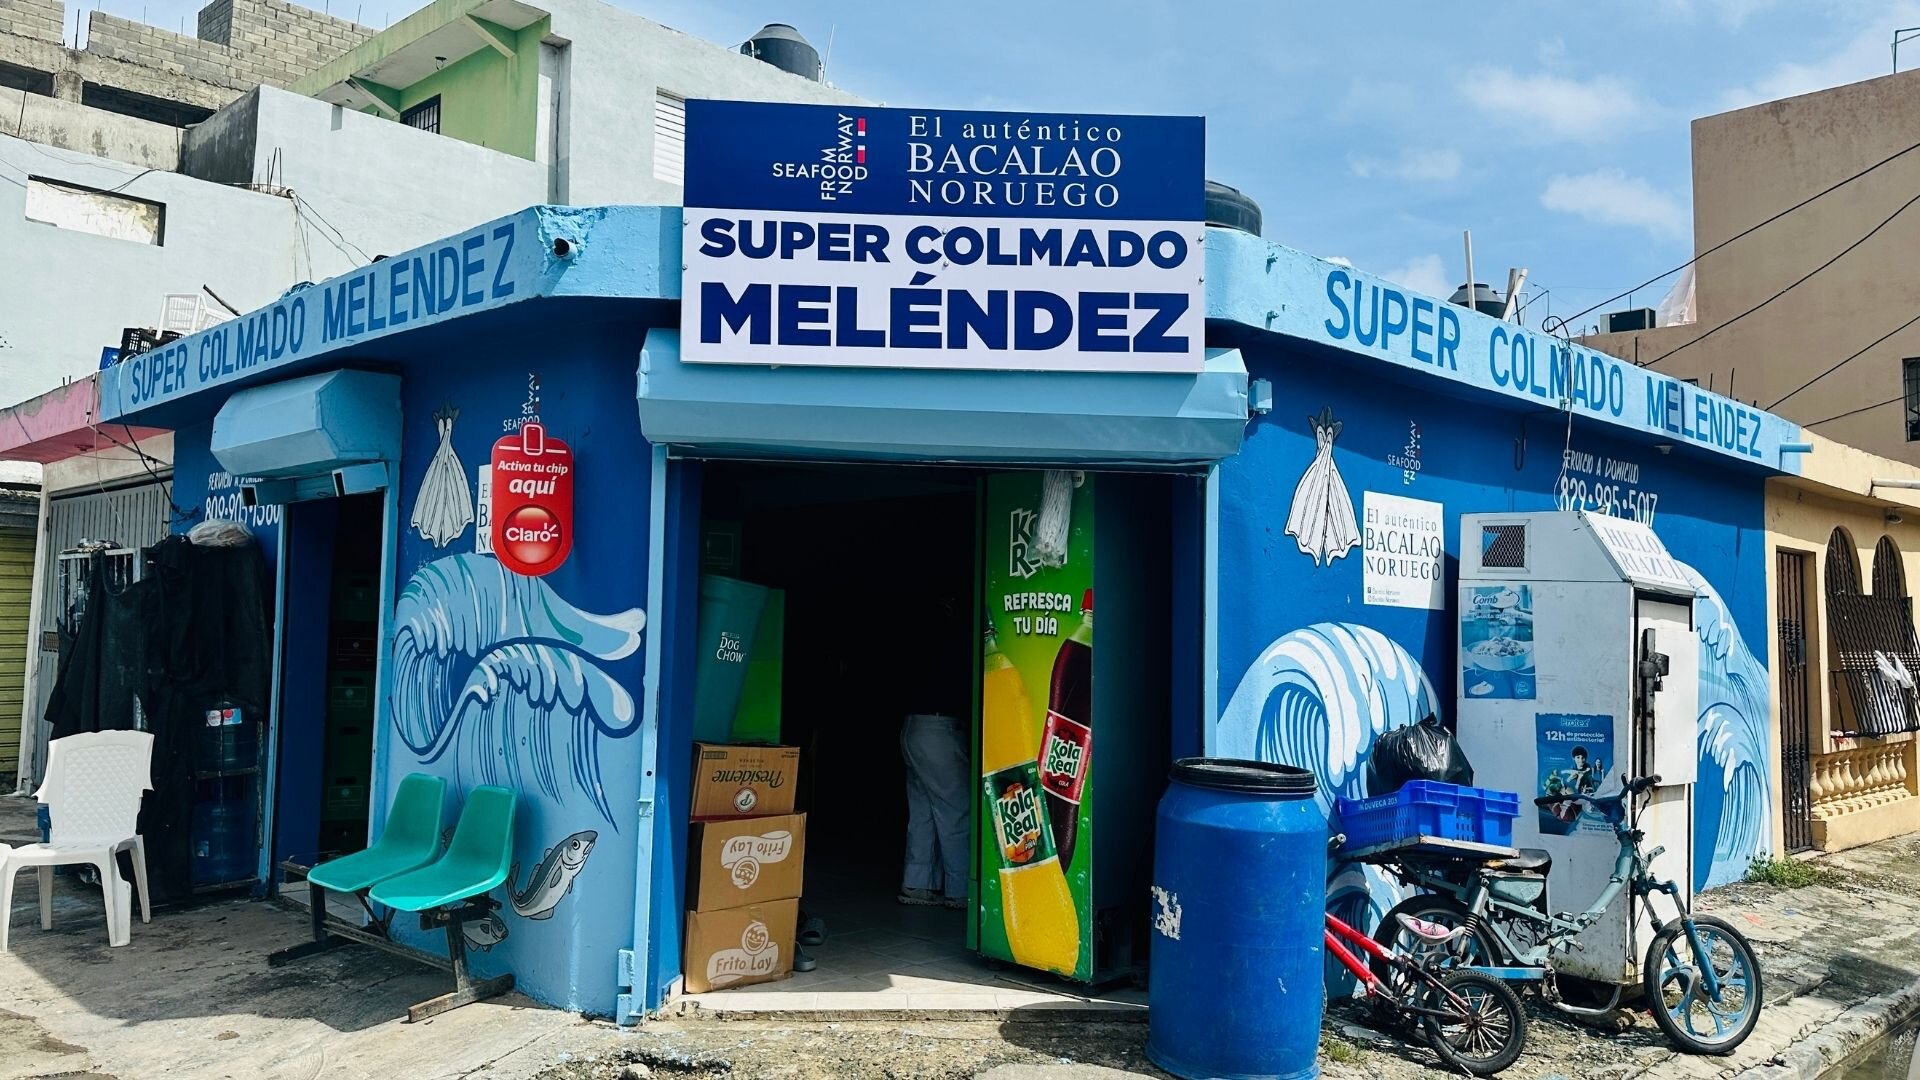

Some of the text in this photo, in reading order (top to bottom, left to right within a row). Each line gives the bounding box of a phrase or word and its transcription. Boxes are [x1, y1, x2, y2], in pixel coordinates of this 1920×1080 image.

[910, 115, 1122, 142] El auténtico
[772, 162, 868, 181] SEAFOOD
[907, 142, 1121, 178] BACALAO
[909, 179, 1120, 208] NORUEGO
[699, 217, 1188, 268] SUPER COLMADO
[130, 223, 516, 405] SUPER COLMADO MELENDEZ
[699, 271, 1190, 353] MELÉNDEZ
[1325, 270, 1763, 459] SUPER COLMADO MELENDEZ
[497, 460, 569, 476] Activa tu chip
[1387, 454, 1421, 471] SEAFOOD
[1596, 456, 1602, 477] A
[509, 476, 556, 499] aquí
[1367, 507, 1437, 532] El auténtico
[506, 525, 554, 543] Claro
[1365, 527, 1441, 560] BACALAO
[1603, 526, 1662, 556] HIELO
[1365, 555, 1441, 582] NORUEGO
[1003, 592, 1072, 612] REFRESCA
[1013, 611, 1058, 635] TU DÍA
[720, 637, 740, 650] DOG
[716, 648, 744, 663] CHOW
[1545, 730, 1566, 742] 12h
[1051, 738, 1081, 760] Kola
[1047, 755, 1078, 776] Real
[711, 770, 784, 789] Presidente
[998, 791, 1035, 823] Kola
[1003, 809, 1038, 845] Real
[729, 839, 785, 857] Frito Lay
[715, 954, 773, 975] Frito Lay
